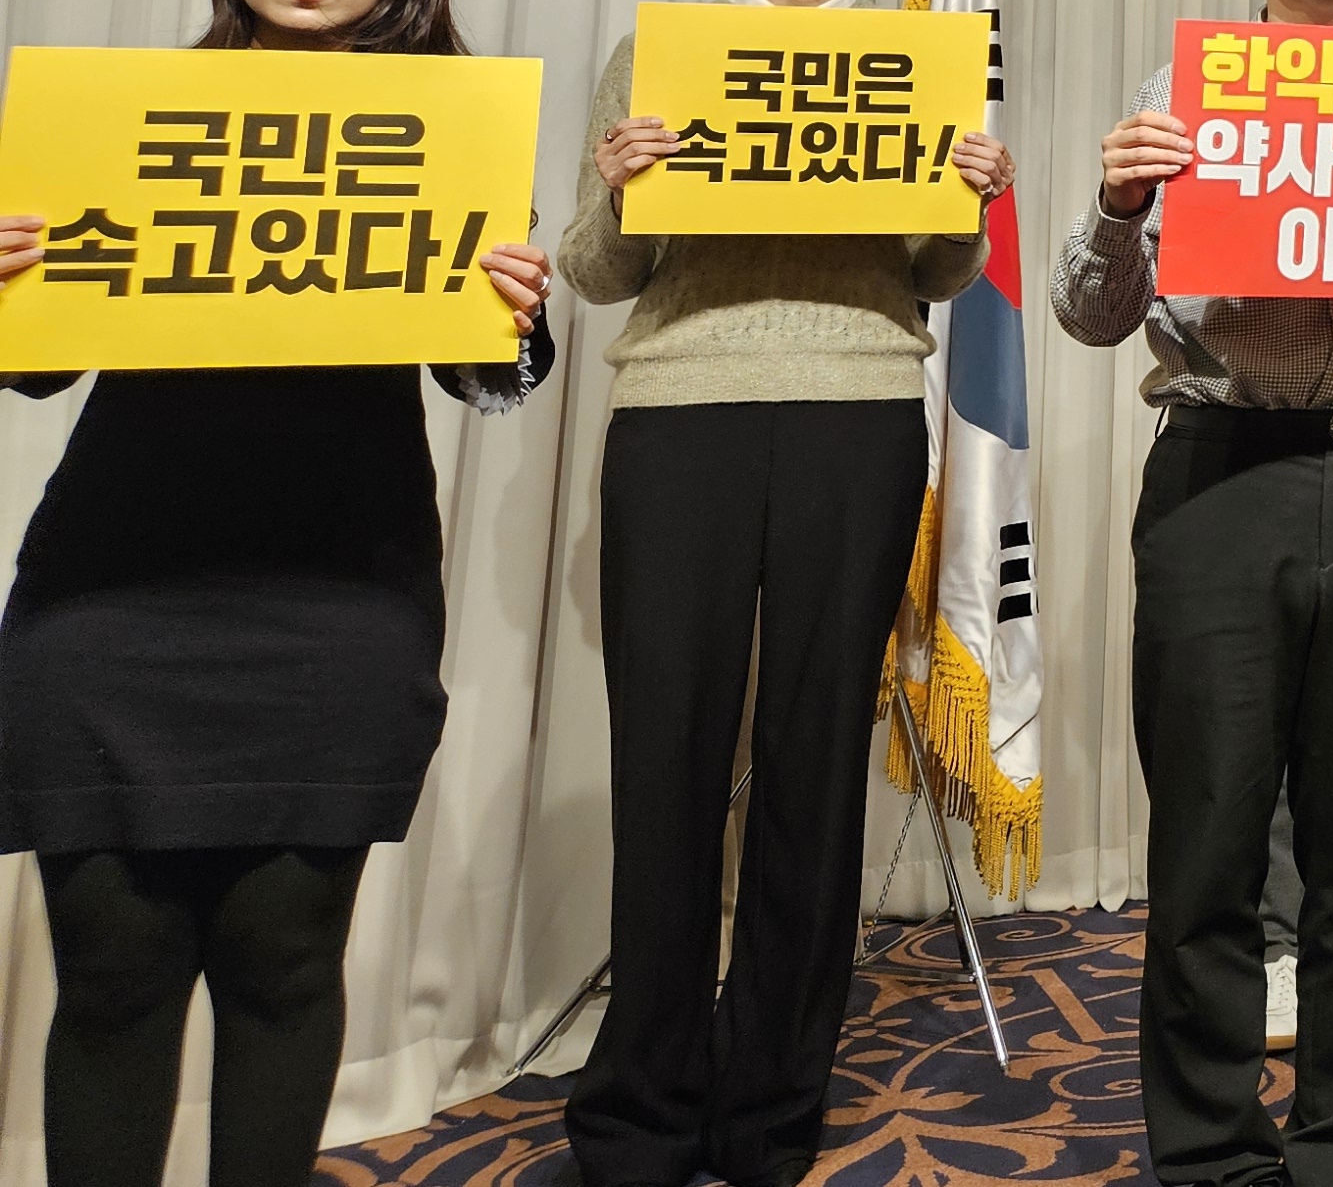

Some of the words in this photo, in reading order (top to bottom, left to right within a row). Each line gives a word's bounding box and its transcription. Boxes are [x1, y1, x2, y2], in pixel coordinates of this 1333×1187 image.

[725, 50, 913, 113] 국민은
[139, 112, 423, 196] 국민은
[666, 120, 956, 184] 속고있다!
[43, 209, 486, 296] 속고있다!
